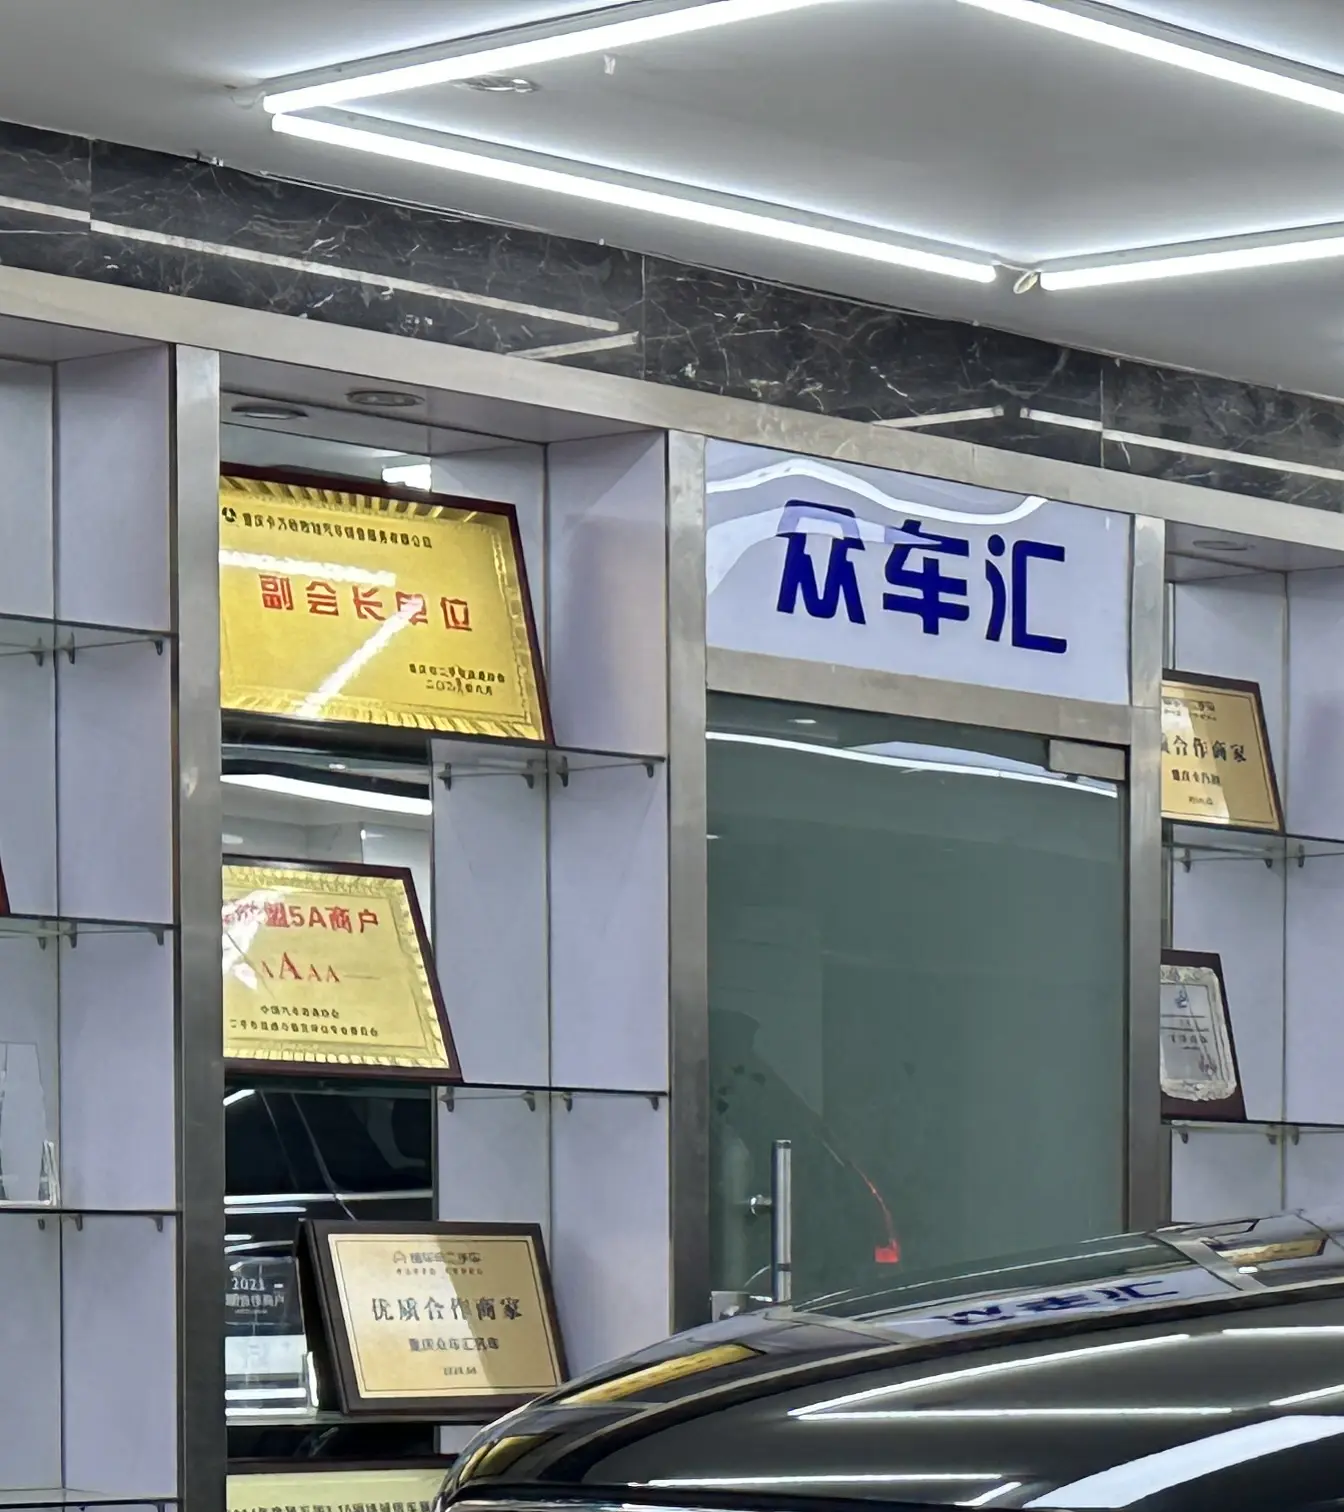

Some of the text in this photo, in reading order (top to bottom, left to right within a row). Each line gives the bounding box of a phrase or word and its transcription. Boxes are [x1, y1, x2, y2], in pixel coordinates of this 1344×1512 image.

[259, 573, 473, 632] 副会长单位
[775, 499, 1068, 655] 众车汇
